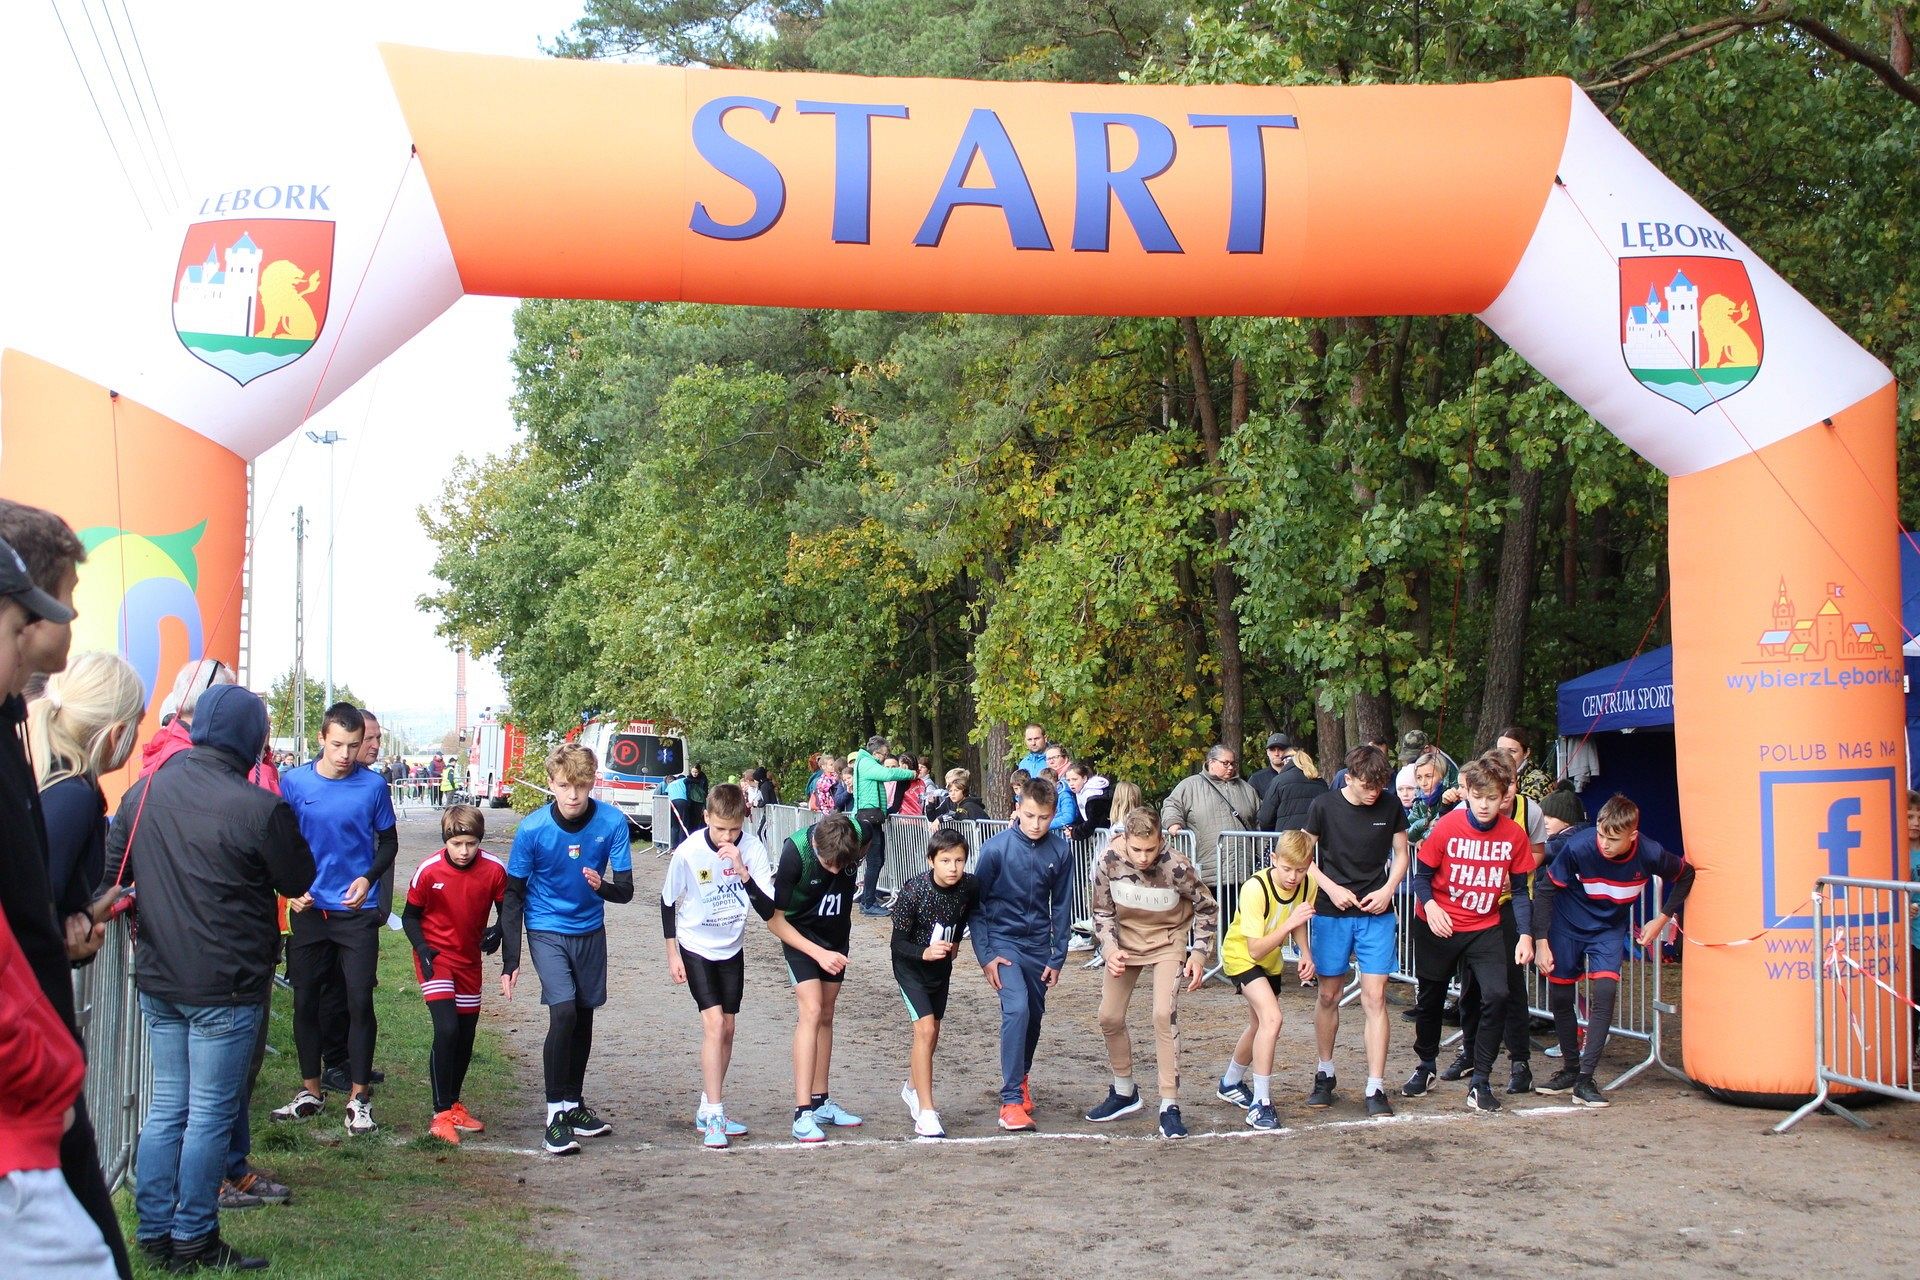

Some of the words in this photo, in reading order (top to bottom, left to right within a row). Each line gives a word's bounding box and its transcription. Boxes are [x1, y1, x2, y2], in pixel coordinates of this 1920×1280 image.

[689, 95, 1300, 255] START
[199, 184, 332, 217] LĘBORK
[1621, 222, 1734, 252] LĘBORK
[1727, 666, 1903, 693] wybierzLębork.p
[1582, 692, 1636, 717] CENTRUM
[1638, 684, 1674, 711] SPORT
[1760, 744, 1827, 762] POLUB
[1839, 742, 1873, 760] NAS
[1880, 741, 1896, 757] NA
[1447, 837, 1513, 861] CHILLER
[1450, 863, 1503, 888] THAN
[1448, 885, 1495, 914] YOU
